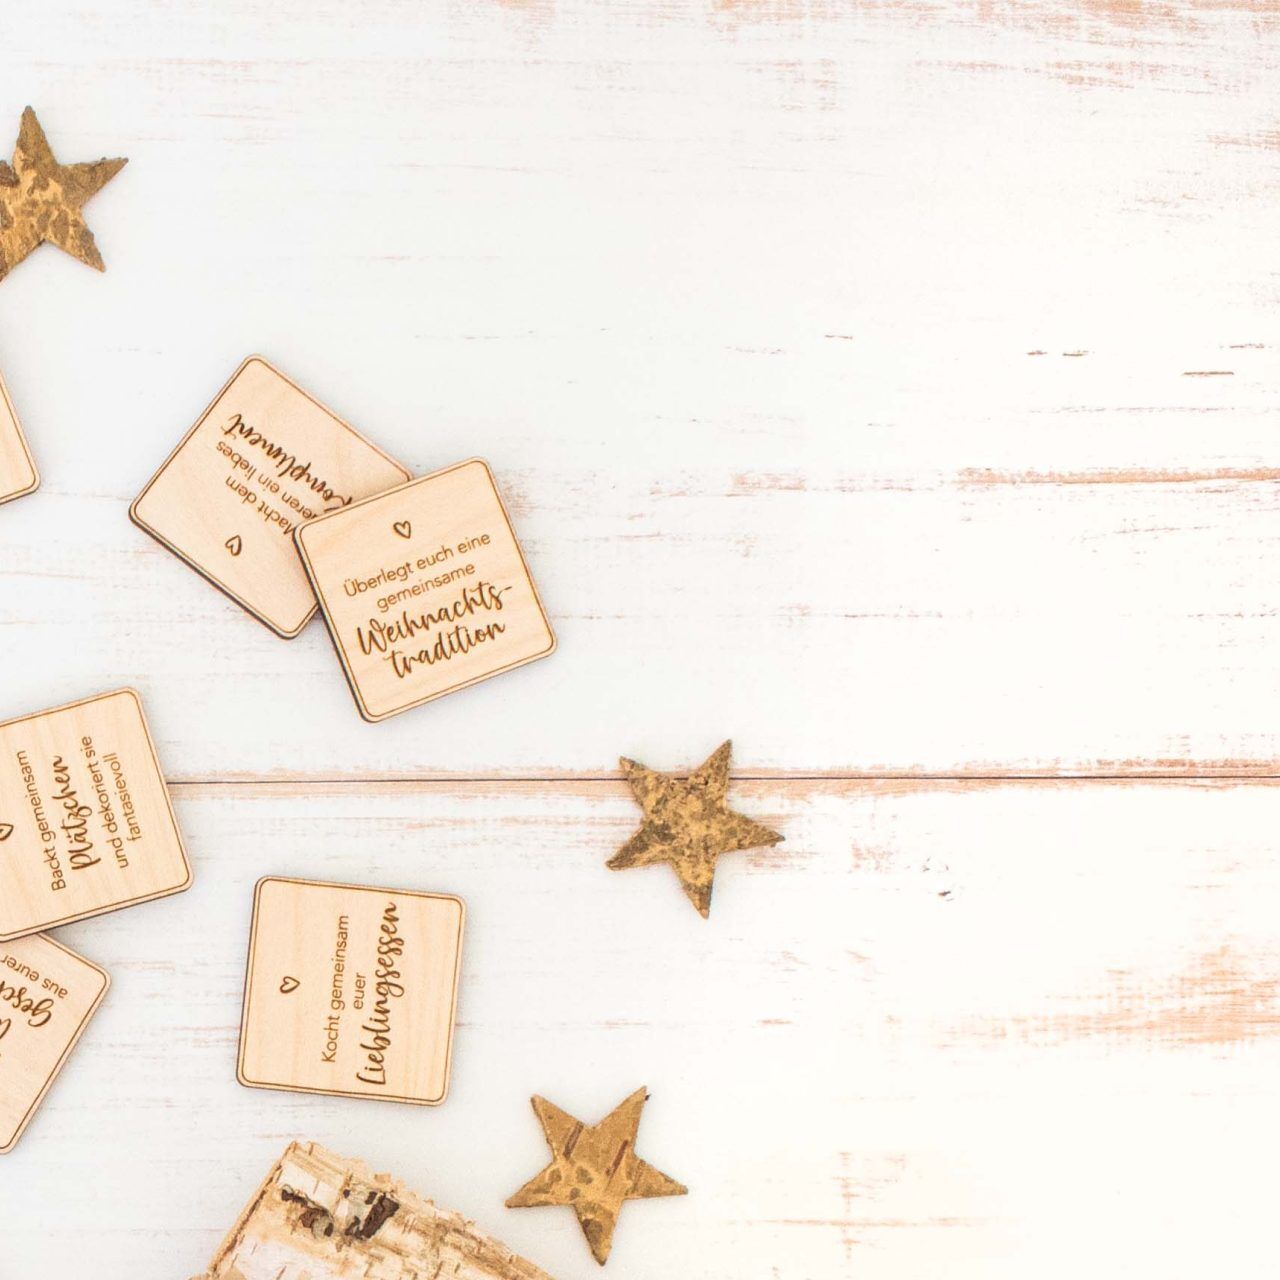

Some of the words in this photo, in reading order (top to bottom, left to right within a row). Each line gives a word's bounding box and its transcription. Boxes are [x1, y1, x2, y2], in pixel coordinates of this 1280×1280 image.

[216, 441, 257, 481] liebes
[257, 473, 280, 494] ein
[225, 475, 258, 504] dem
[281, 491, 317, 521] eren
[343, 561, 415, 597] Überlegt
[416, 545, 454, 570] euch
[457, 533, 491, 554] eine
[376, 563, 476, 614] gemeinsame
[356, 581, 513, 656] Weihnachts-
[383, 622, 506, 679] tradition
[80, 736, 96, 759] sie
[16, 750, 57, 843] gemeinsam
[51, 755, 102, 871] Plätzchen
[86, 760, 119, 834] dekoriert
[102, 752, 143, 842] fantasievoll
[43, 845, 67, 892] Backt
[106, 836, 129, 869] und
[0, 954, 40, 982] eurer
[330, 915, 349, 1011] gemeinsam
[41, 977, 69, 1000] aus
[352, 972, 367, 1010] euer
[355, 902, 405, 1086] Lieblingsessen
[321, 1015, 341, 1063] Kocht
